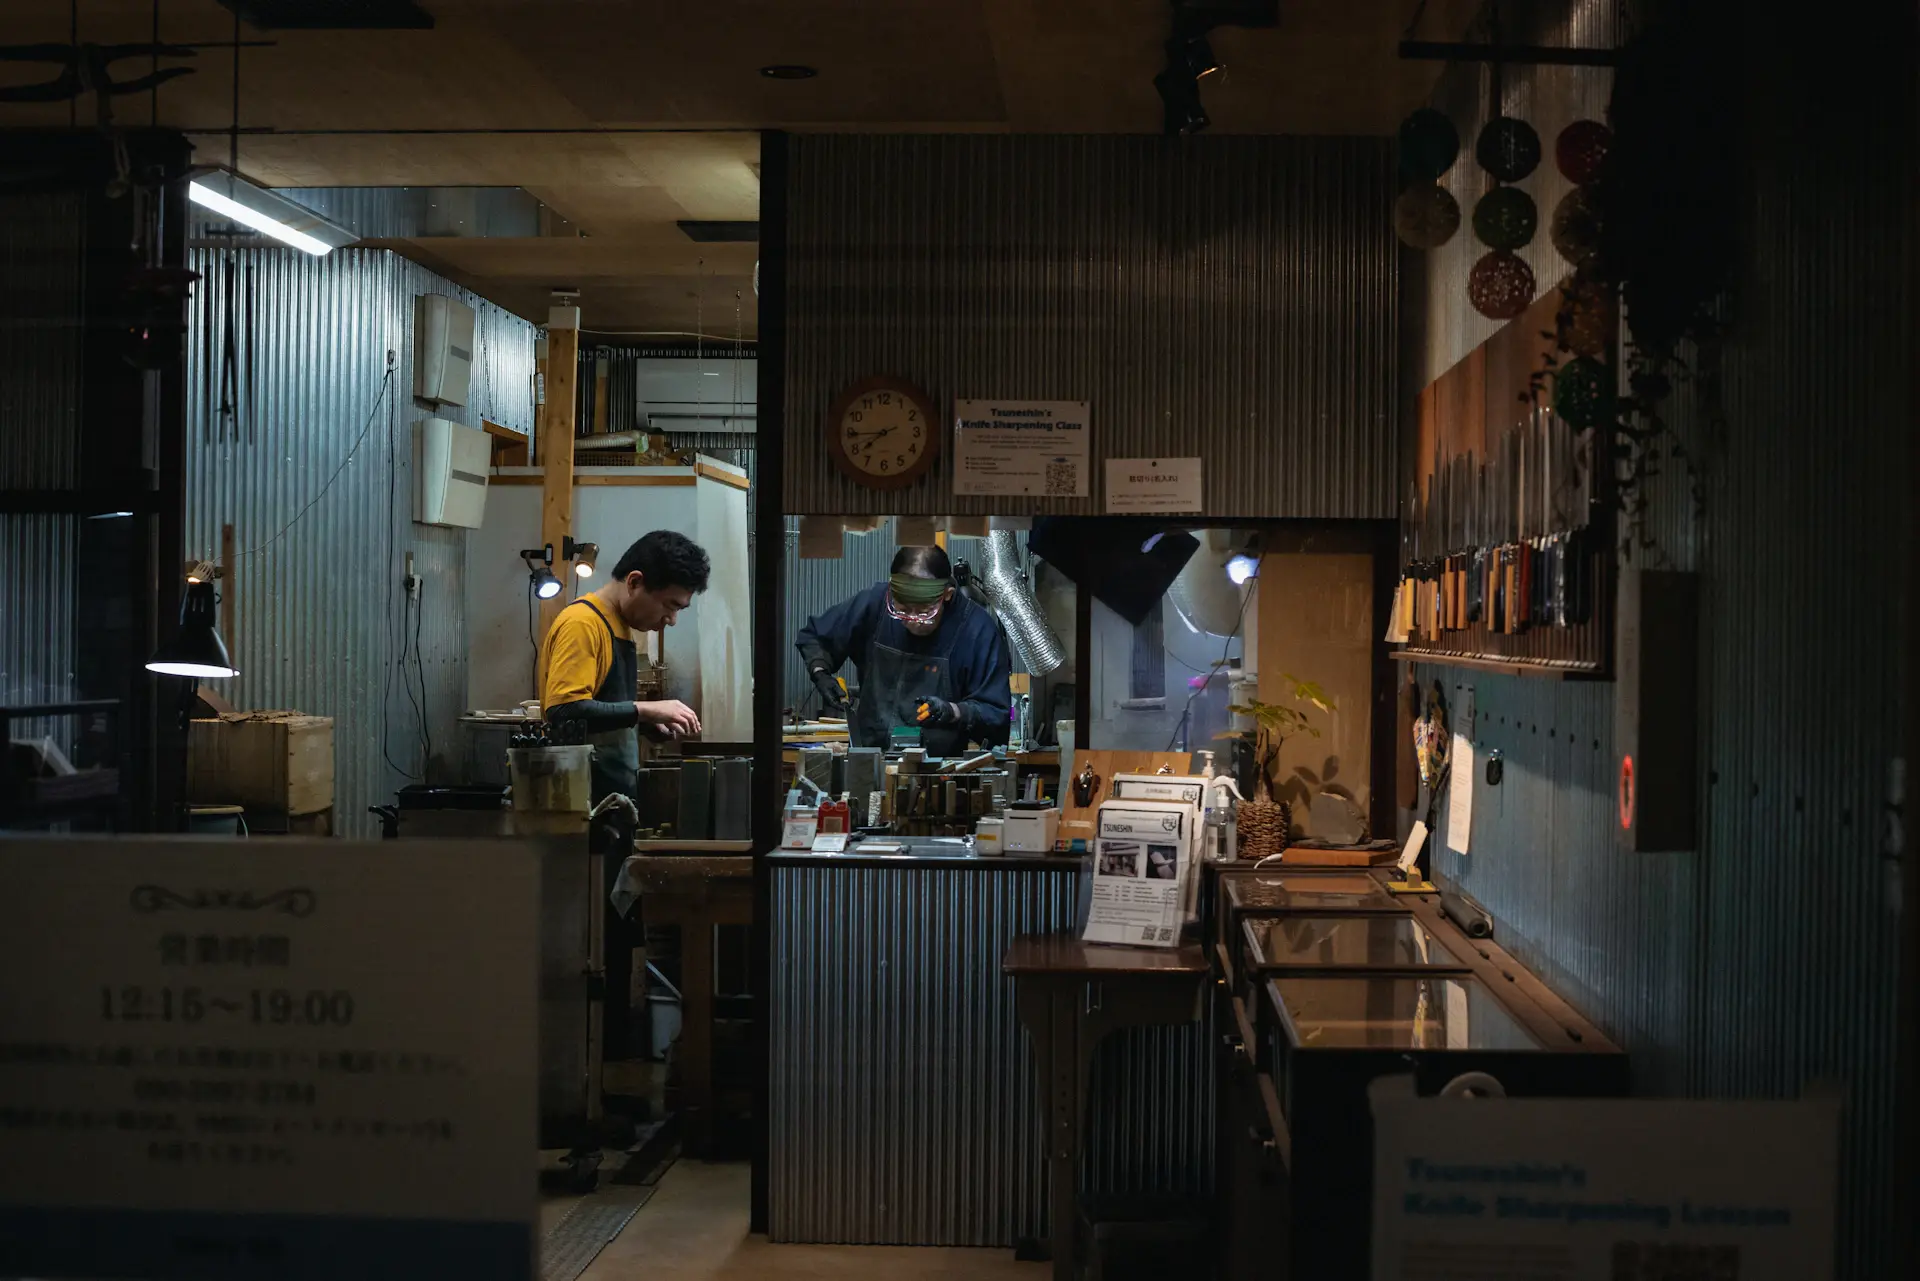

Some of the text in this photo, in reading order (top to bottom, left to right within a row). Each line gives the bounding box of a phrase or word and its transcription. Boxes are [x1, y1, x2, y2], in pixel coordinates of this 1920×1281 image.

[863, 399, 873, 409] 11
[877, 393, 891, 405] 12
[898, 398, 904, 409] 1
[849, 411, 863, 422] 10
[908, 409, 917, 422] 2
[990, 408, 1052, 417] Tsuneshin's
[912, 426, 921, 438] 3
[962, 421, 1082, 431] Knife Sharpening Class
[851, 443, 860, 455] 8
[907, 443, 917, 455] 4
[863, 455, 872, 467] 7
[879, 459, 889, 471] 6
[896, 454, 905, 467] 5
[1103, 823, 1133, 833] TSUNESHIN
